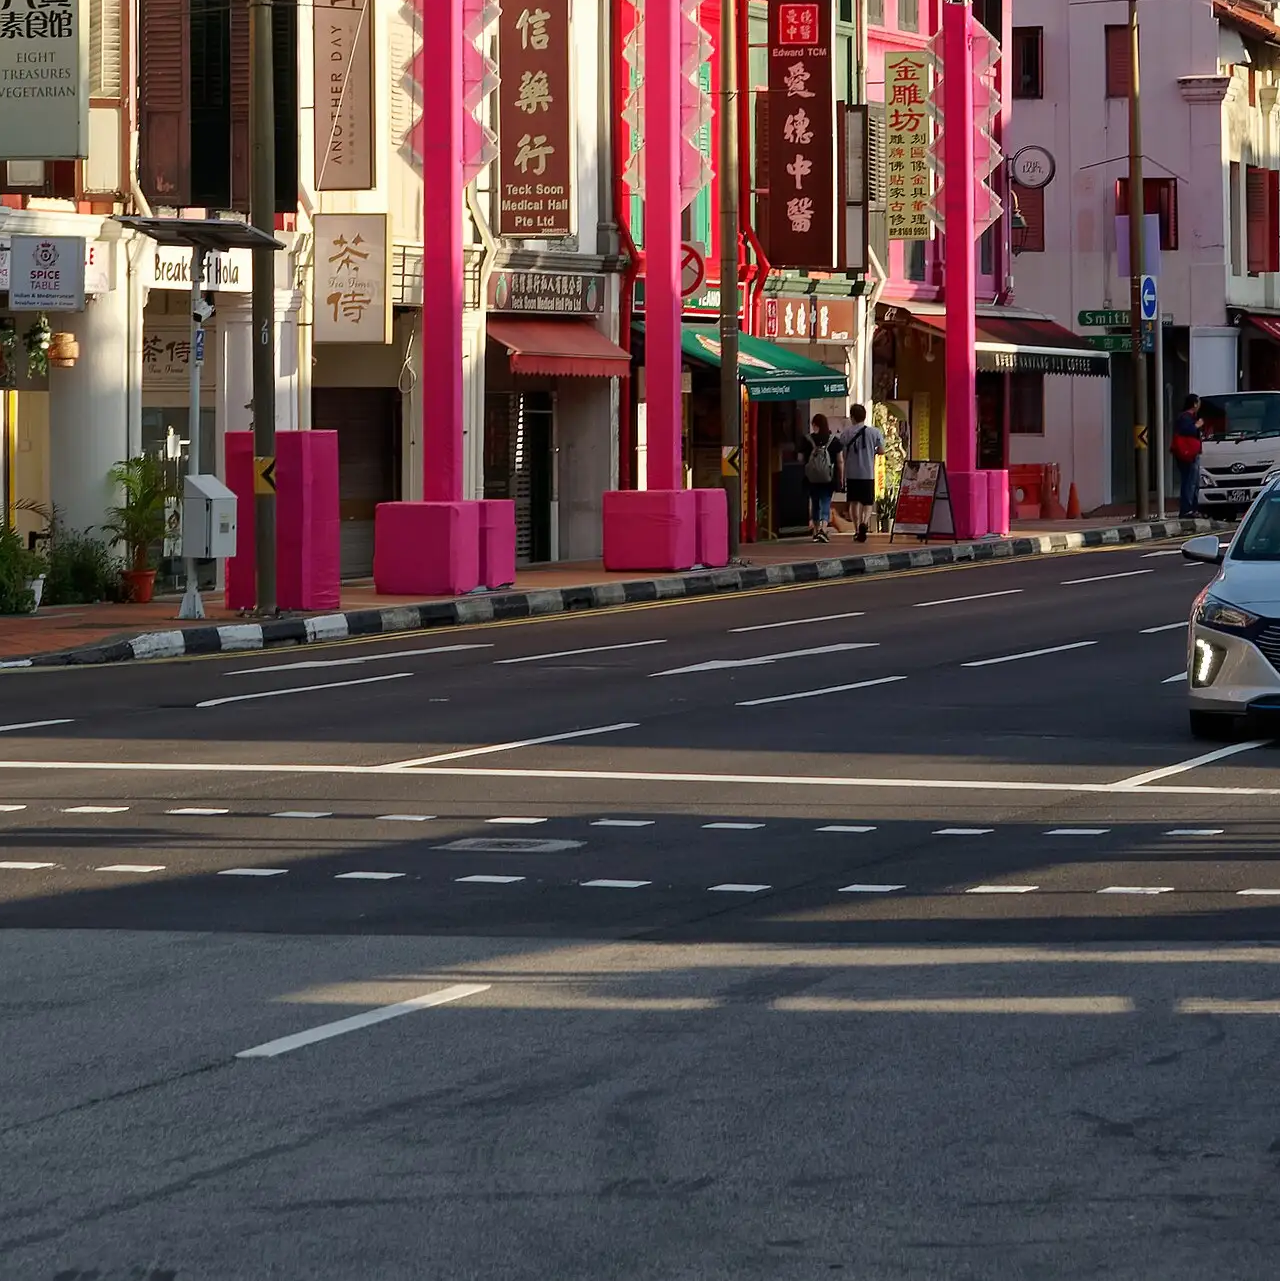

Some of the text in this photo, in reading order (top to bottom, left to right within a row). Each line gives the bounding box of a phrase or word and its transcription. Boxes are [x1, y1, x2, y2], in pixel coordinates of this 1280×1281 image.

[0, 9, 73, 39] 素食馆
[16, 51, 56, 63] EIGHT
[772, 47, 827, 57] Edward TCM
[2, 68, 71, 80] TREASURES
[330, 24, 343, 166] ANOTHER DAY
[888, 57, 926, 133] 金雕坊
[783, 61, 816, 234] 愛德中醫
[505, 184, 564, 195] Teck Soon
[502, 199, 568, 211] Medical Hall
[515, 216, 555, 227] Pte Ltd
[30, 270, 60, 280] SPICE
[215, 256, 240, 285] Hola
[31, 281, 60, 291] TABLE
[511, 295, 523, 309] Teck
[524, 295, 537, 310] Soon
[537, 296, 555, 311] Medical
[1085, 311, 1130, 325] Smith
[1067, 358, 1091, 371] COFFEE
